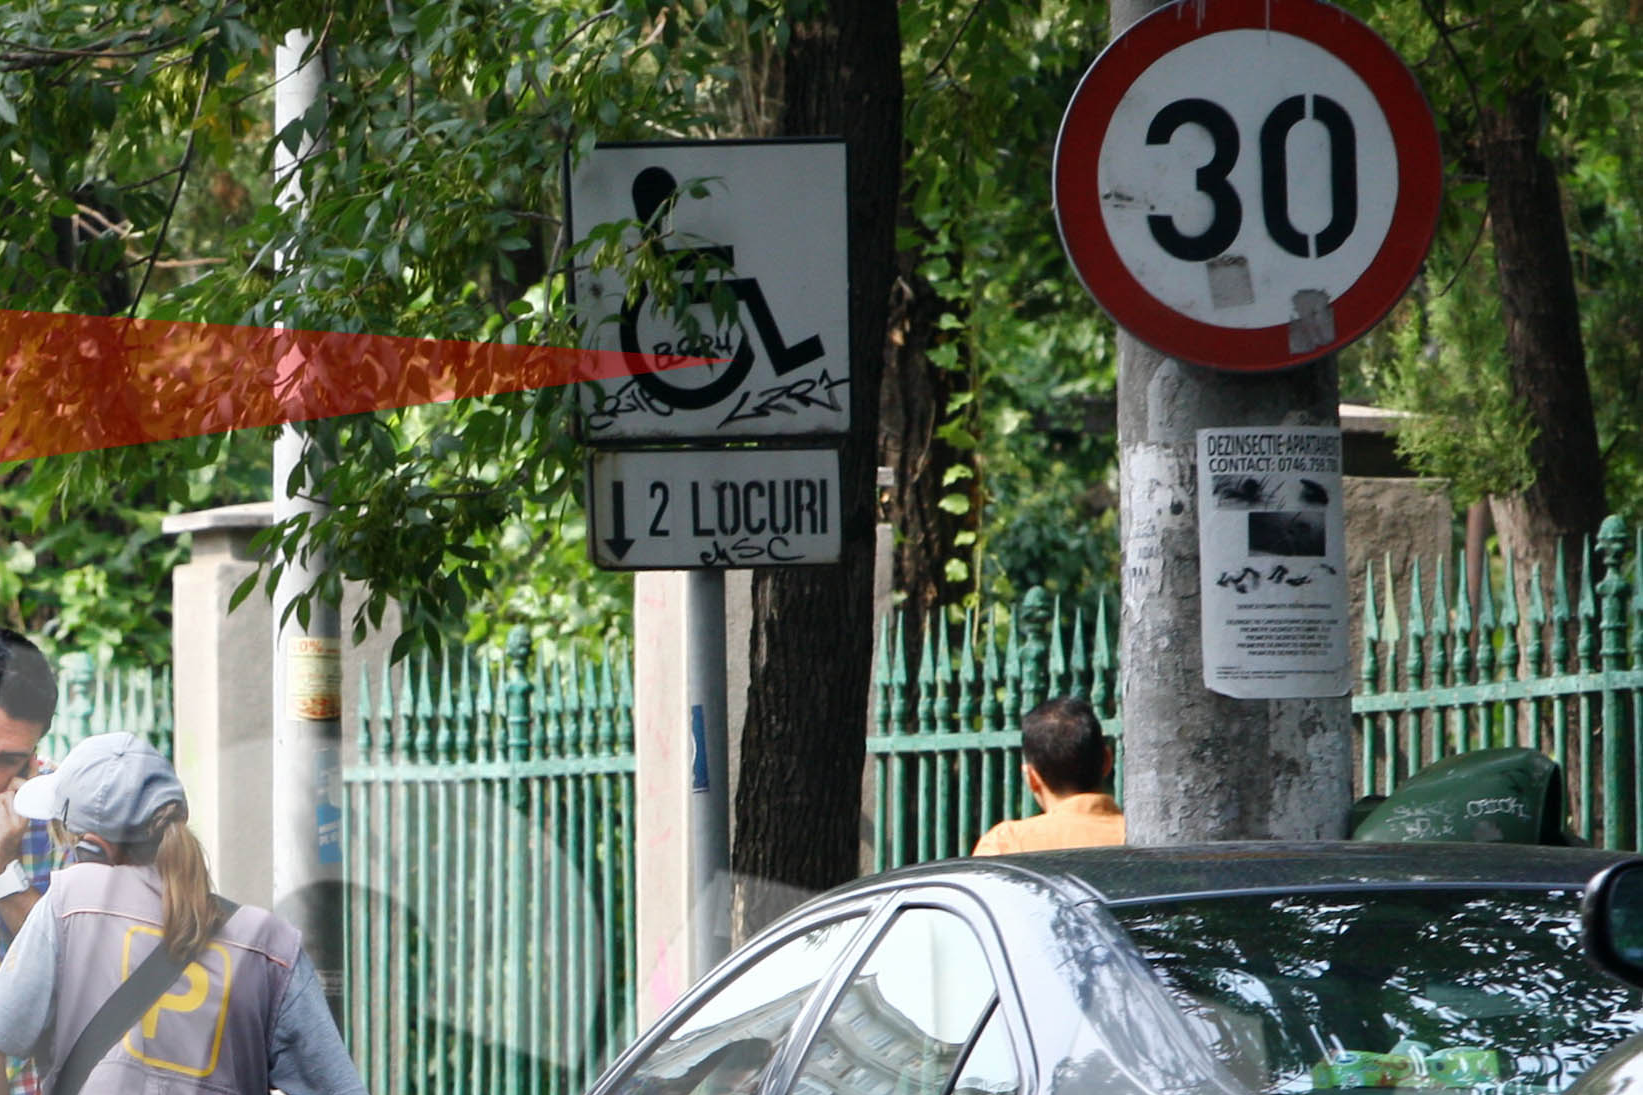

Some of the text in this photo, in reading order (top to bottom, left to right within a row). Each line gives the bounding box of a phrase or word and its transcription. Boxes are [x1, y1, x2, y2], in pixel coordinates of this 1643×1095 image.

[1145, 94, 1358, 262] 30
[1208, 457, 1275, 473] CONTACT:
[649, 479, 829, 537] 2 LOCURI
